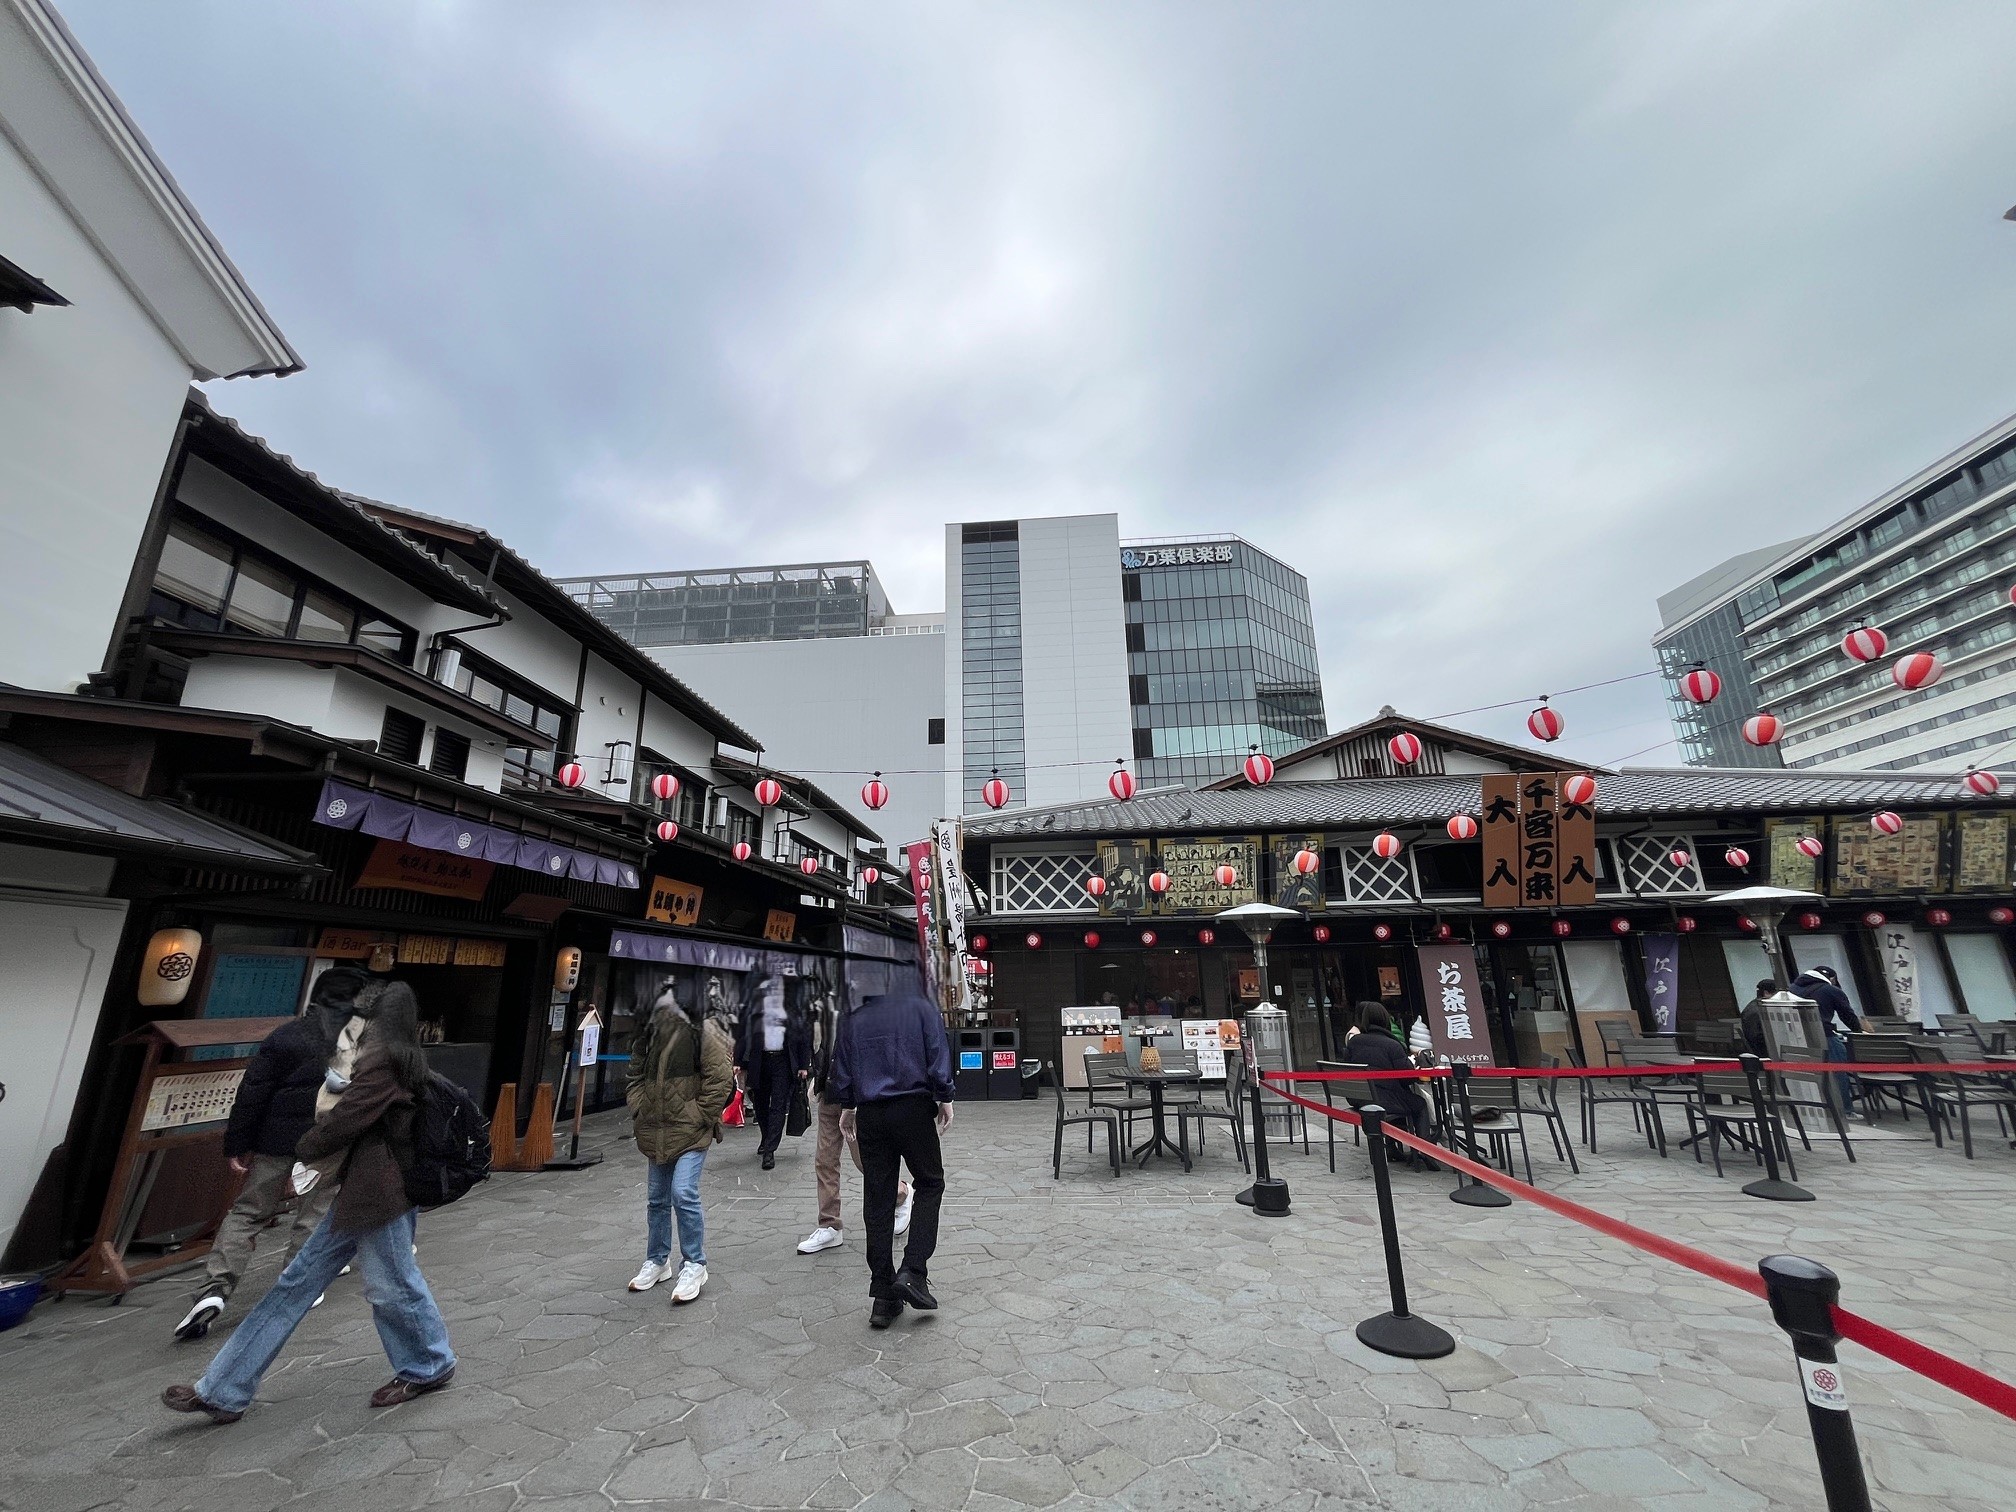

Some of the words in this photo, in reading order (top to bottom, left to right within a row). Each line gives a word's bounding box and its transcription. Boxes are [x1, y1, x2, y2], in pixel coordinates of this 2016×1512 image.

[1140, 545, 1234, 567] 万葉倶楽部
[1523, 778, 1555, 900] 千客万来
[341, 937, 366, 950] Bar
[1437, 961, 1474, 1040] お茶屋
[1652, 957, 1672, 1026] 江戸前
